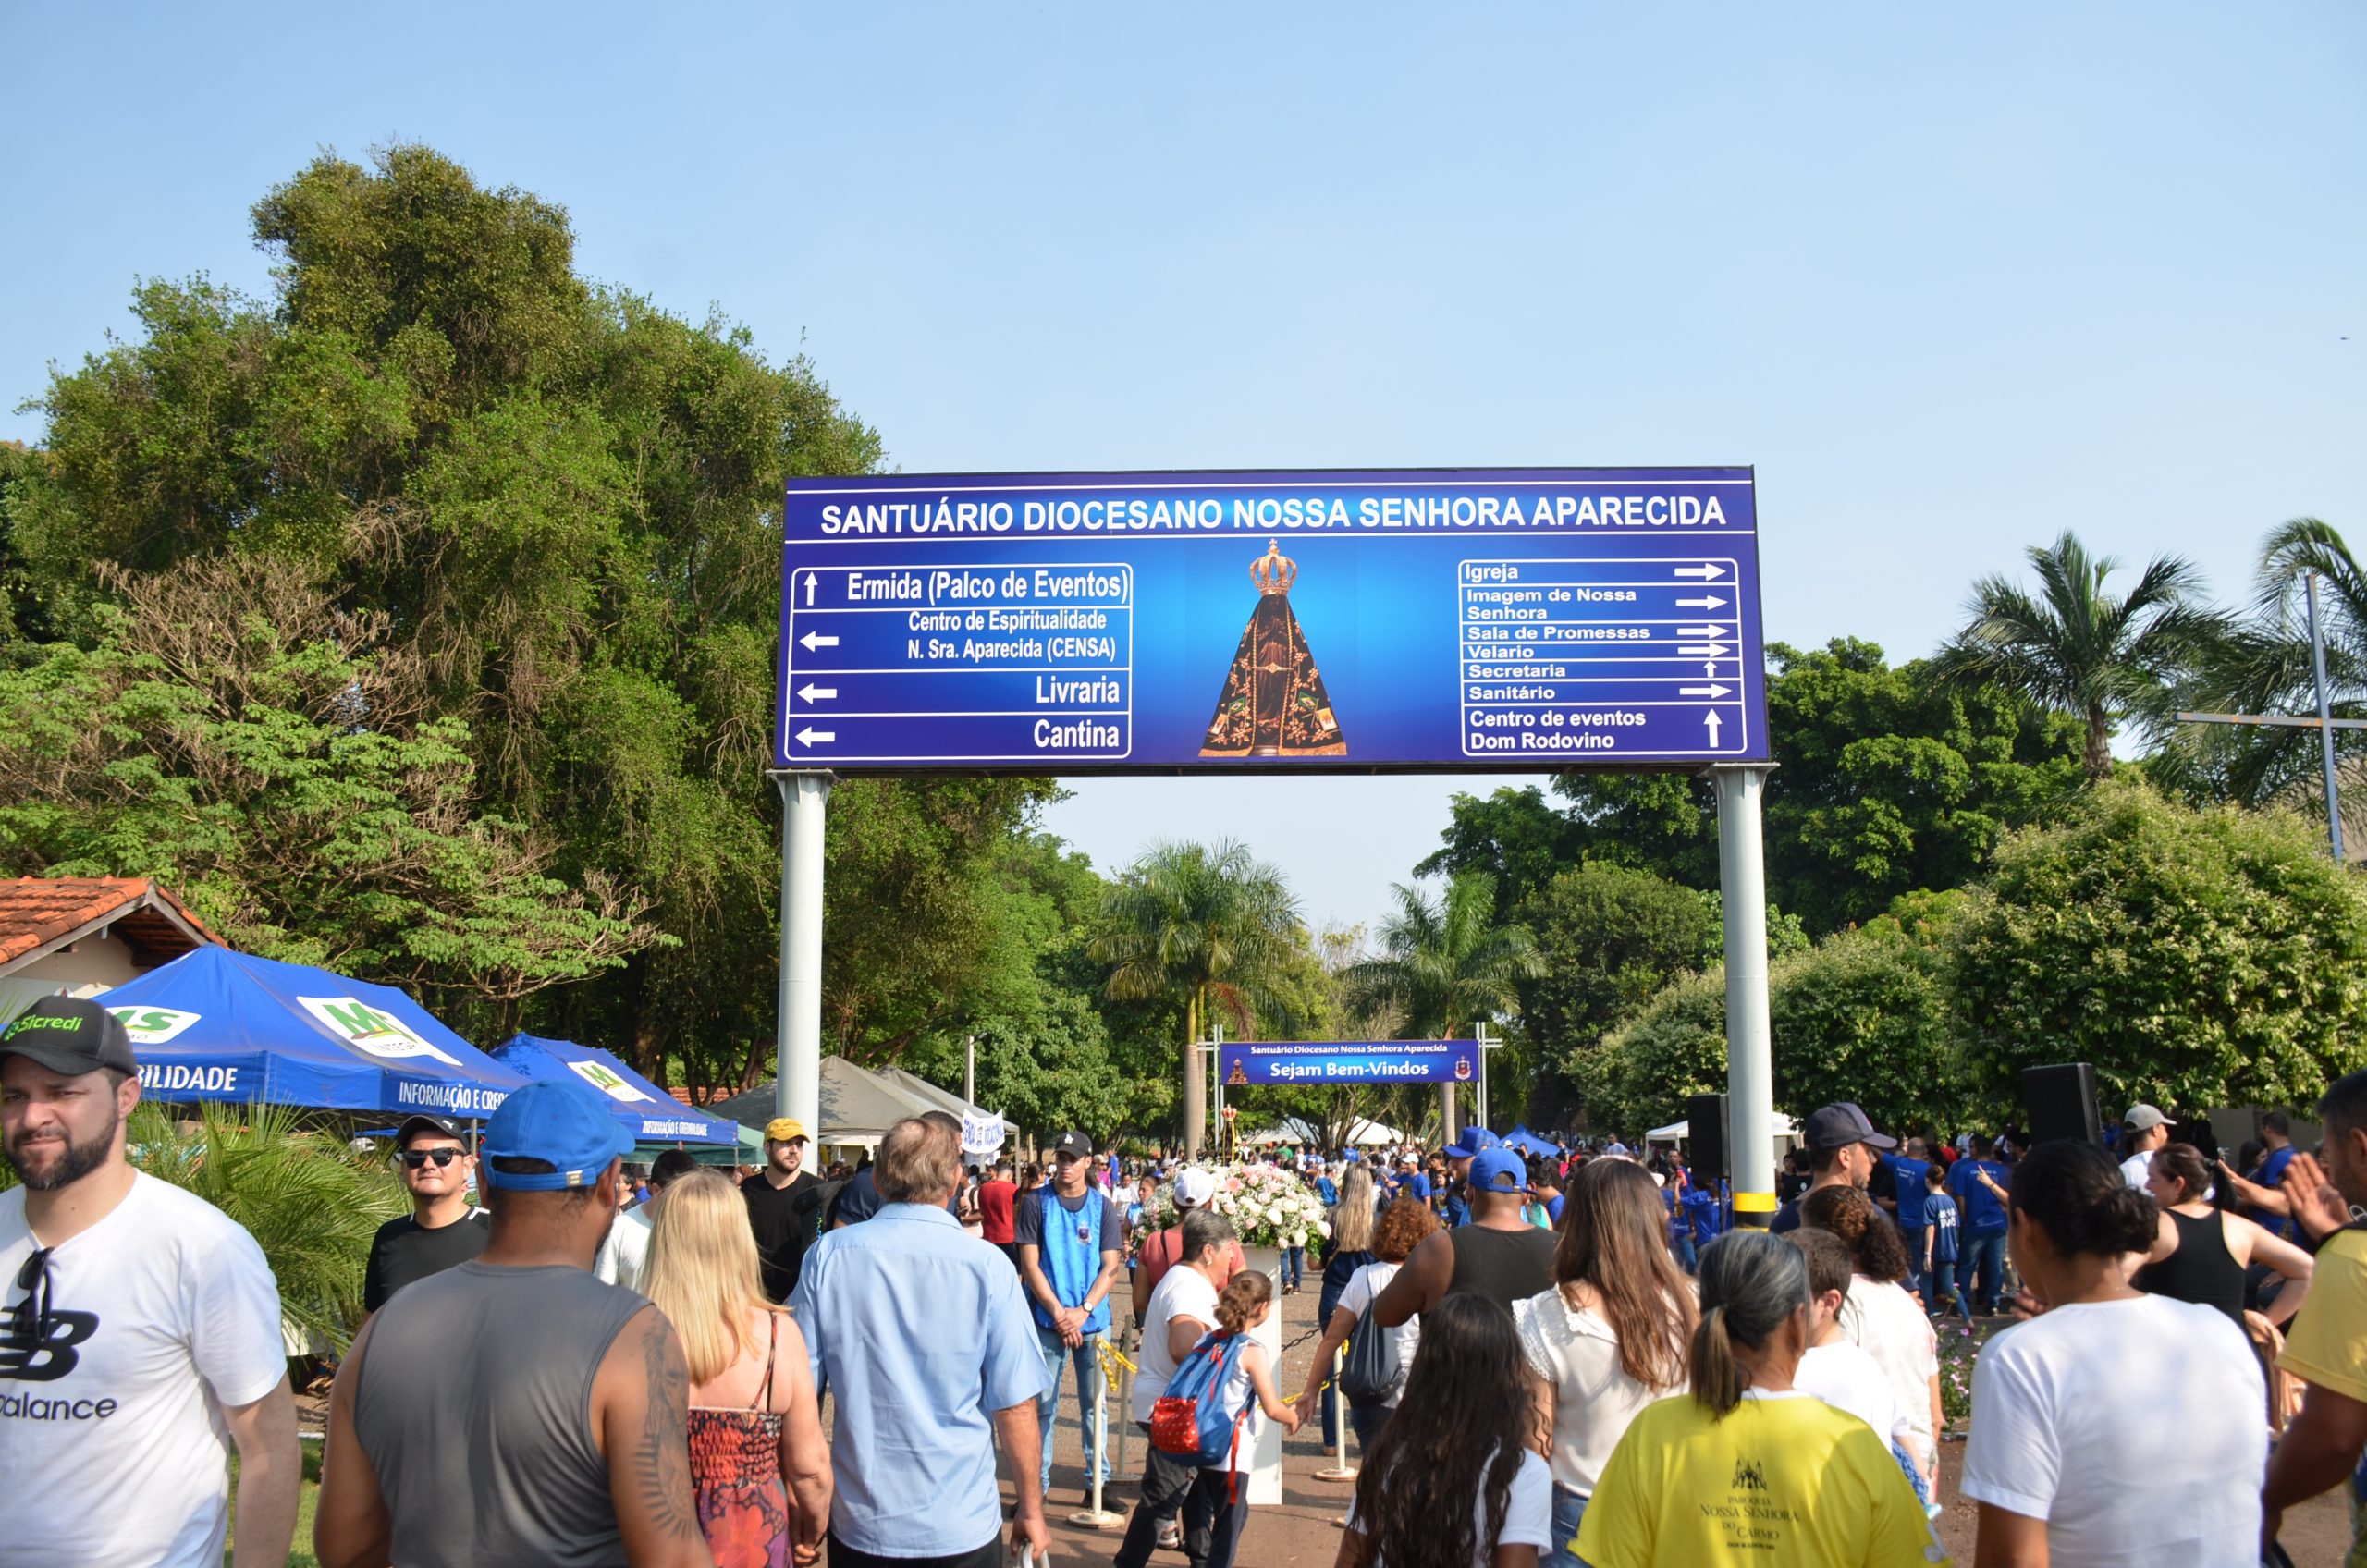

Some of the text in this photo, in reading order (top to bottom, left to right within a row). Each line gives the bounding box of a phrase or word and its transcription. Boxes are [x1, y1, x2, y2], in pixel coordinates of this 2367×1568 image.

[821, 496, 1726, 534] SANTUÁRIO DIOCESANO NOSSA SENHORA APARECIDA
[1466, 563, 1519, 583] Igreja
[848, 570, 1128, 606] Ermida (Palco de Eventos)
[1467, 589, 1637, 606] Imagem de Nossa
[908, 610, 1107, 634] Centro de Espiritualidade
[1467, 606, 1548, 620] Senhora
[1468, 625, 1650, 640] Sala de Promessas
[908, 637, 1115, 662] N. Sra. Aparecida (CENSA)
[1468, 644, 1535, 659] Velario
[1469, 664, 1566, 678] Secretaria
[1036, 675, 1120, 704] Livraria
[1469, 685, 1555, 700] Sanitário
[1470, 710, 1646, 728] Centro de eventos
[1034, 718, 1120, 748] Cantina
[1470, 731, 1614, 750] Dom Rodovino
[18, 1014, 83, 1034] Sicredi
[1250, 1046, 1294, 1054] Santuário
[1294, 1046, 1340, 1054] Diocesano
[1367, 1045, 1403, 1053] Senhora
[1404, 1045, 1448, 1054] Aparecida
[1270, 1060, 1429, 1080] Sejam Bem-Vindos
[399, 1081, 470, 1112] INFORMAÇÃO
[473, 1088, 480, 1109] E
